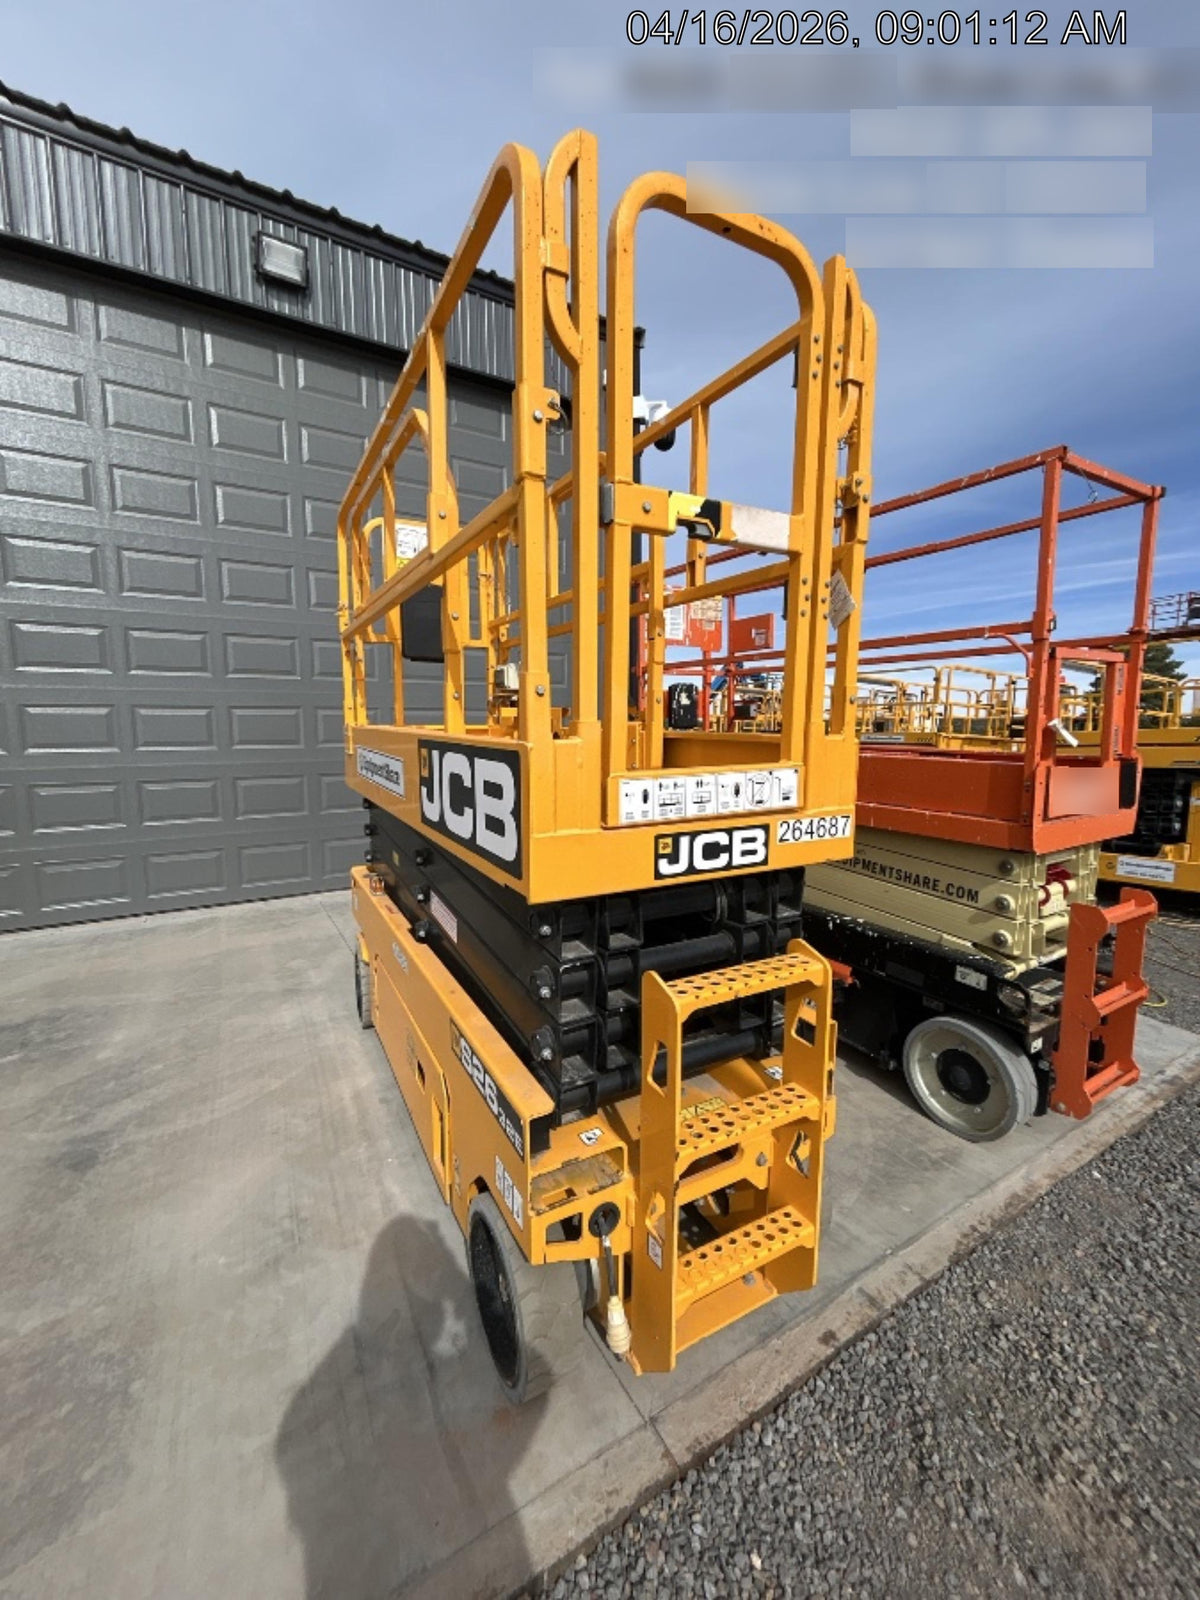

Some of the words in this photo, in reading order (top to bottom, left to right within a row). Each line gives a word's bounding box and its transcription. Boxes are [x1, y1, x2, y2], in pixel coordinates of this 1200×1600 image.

[421, 749, 518, 861] JCB
[658, 828, 767, 875] JCB
[779, 815, 851, 843] 264687
[836, 856, 979, 904] IPMENTSHARE.COM
